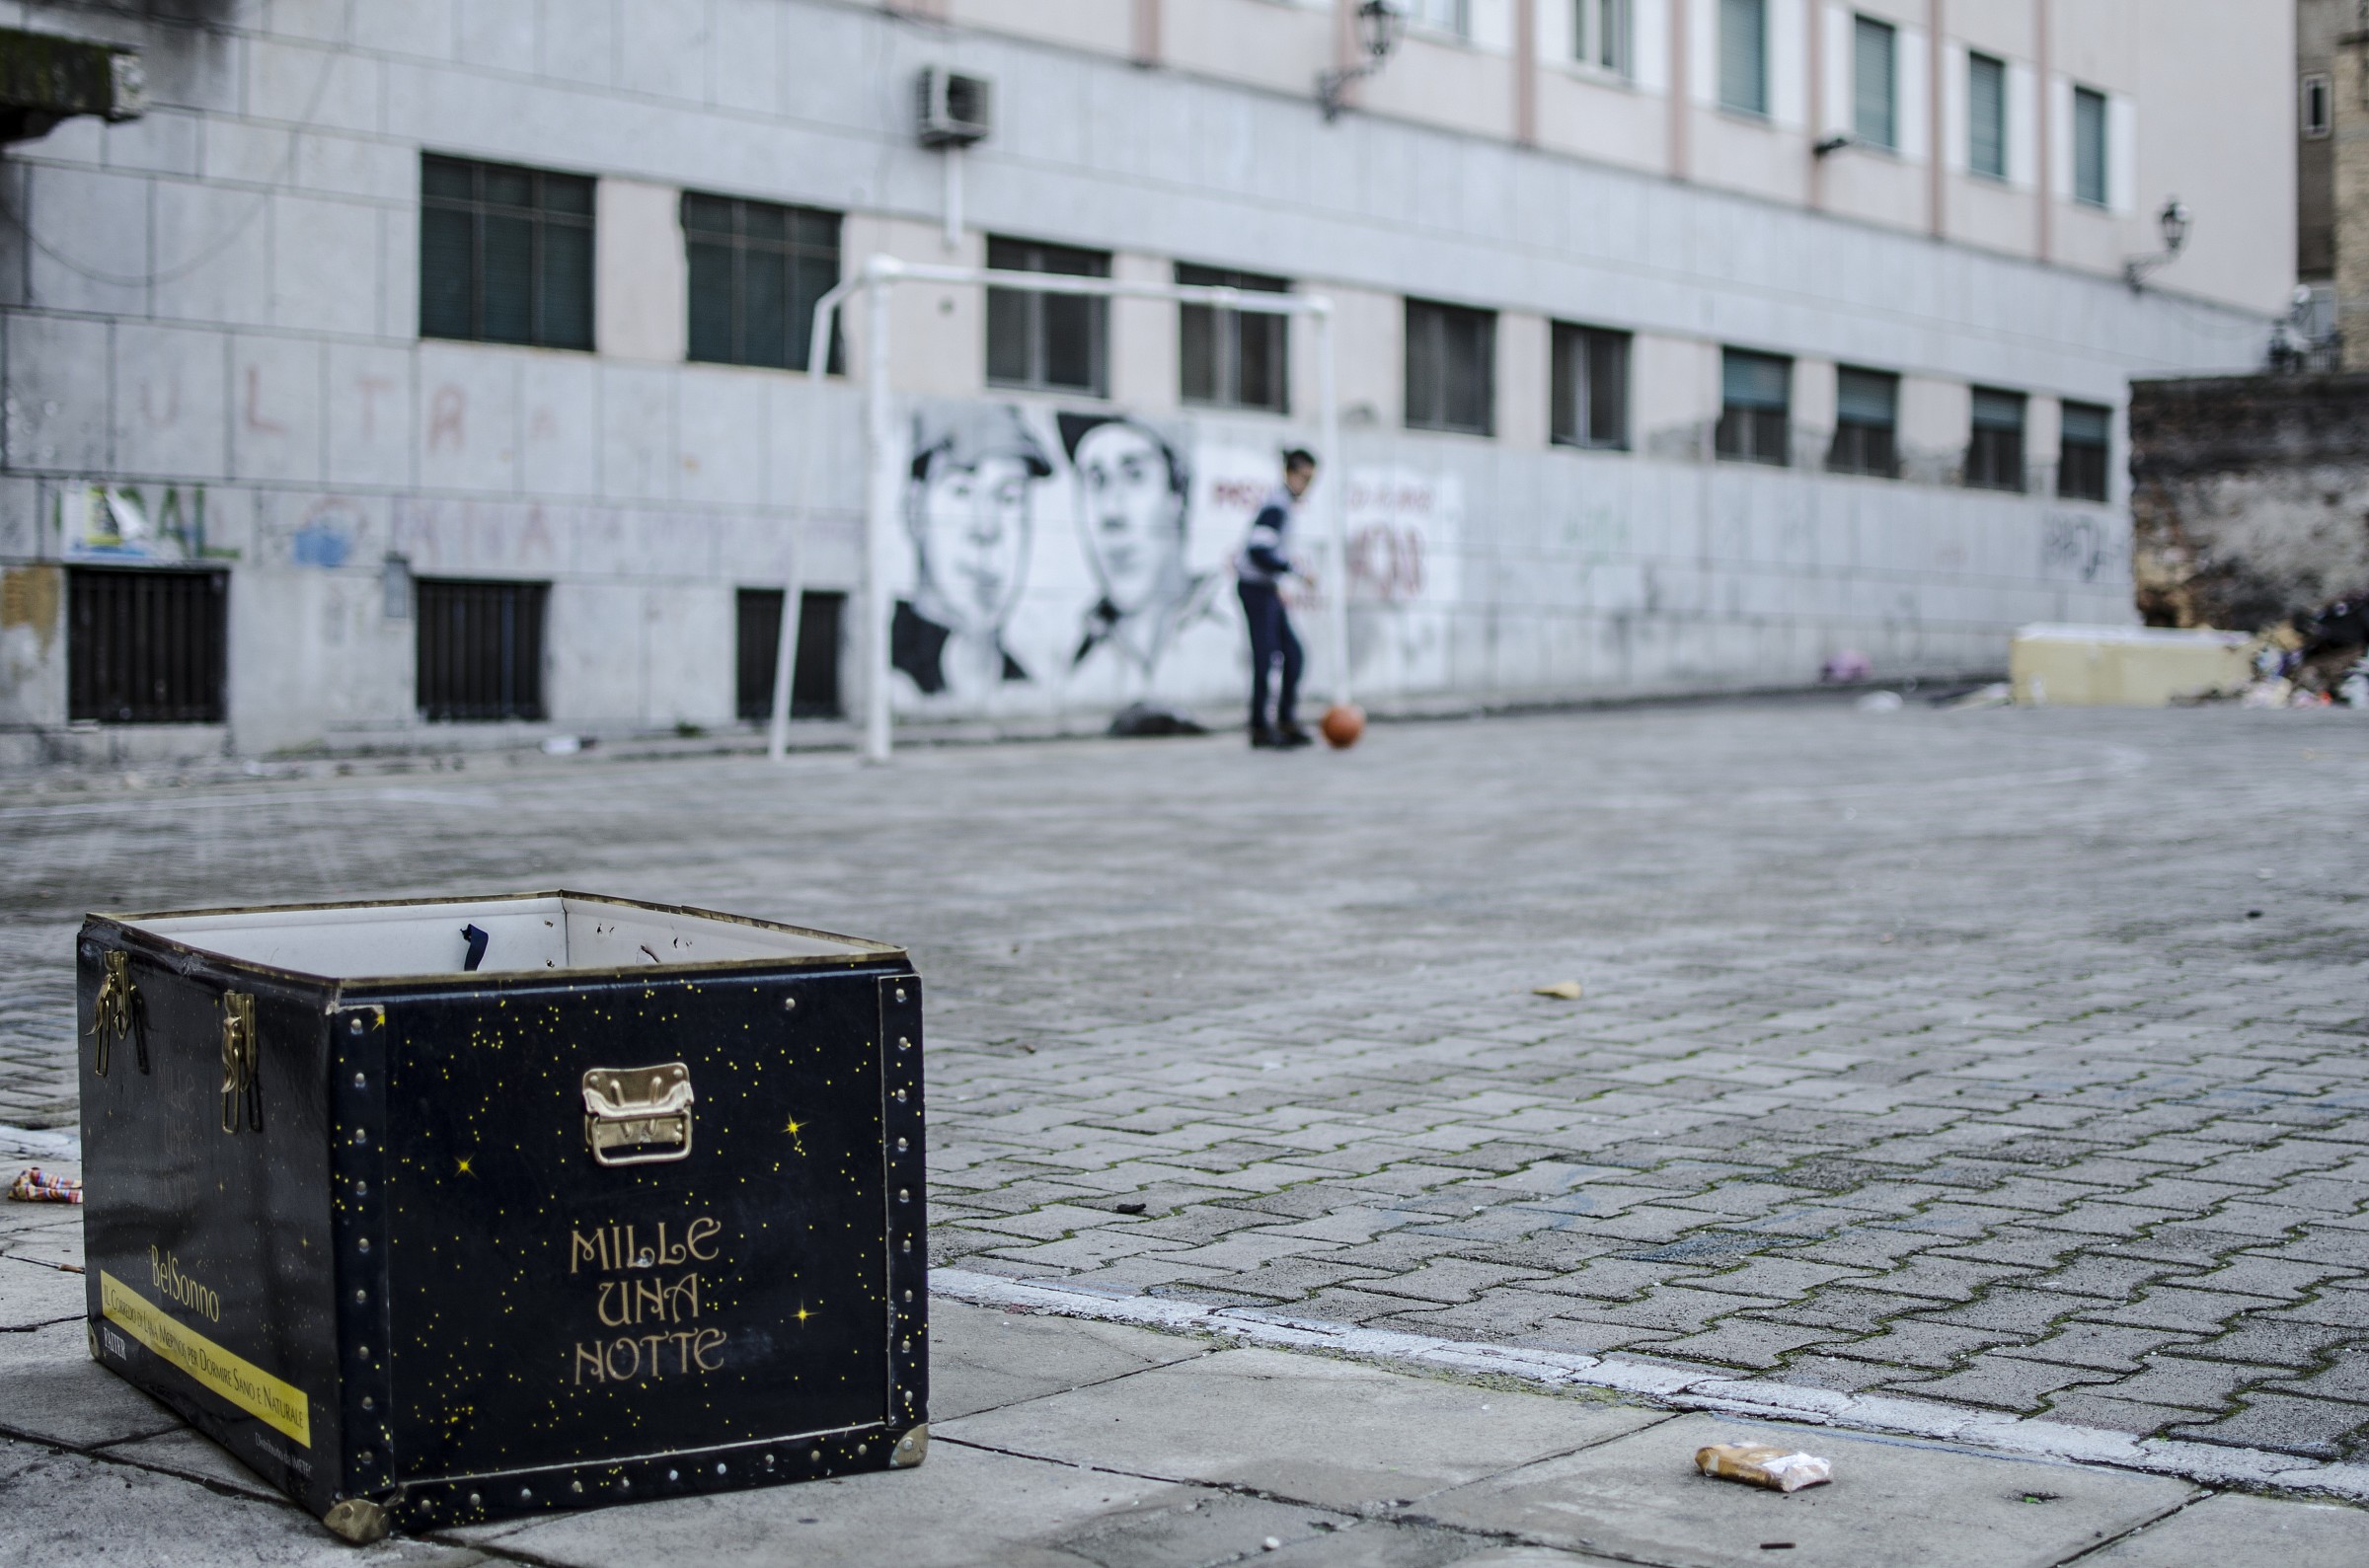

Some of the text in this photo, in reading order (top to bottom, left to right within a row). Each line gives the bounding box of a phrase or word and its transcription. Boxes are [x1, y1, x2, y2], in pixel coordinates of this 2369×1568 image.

[571, 1217, 722, 1274] MILLE
[151, 1243, 219, 1322] BelSonno
[597, 1272, 700, 1327] UNA
[574, 1327, 726, 1385] NOTTE
[263, 1385, 304, 1430] NATURALE
